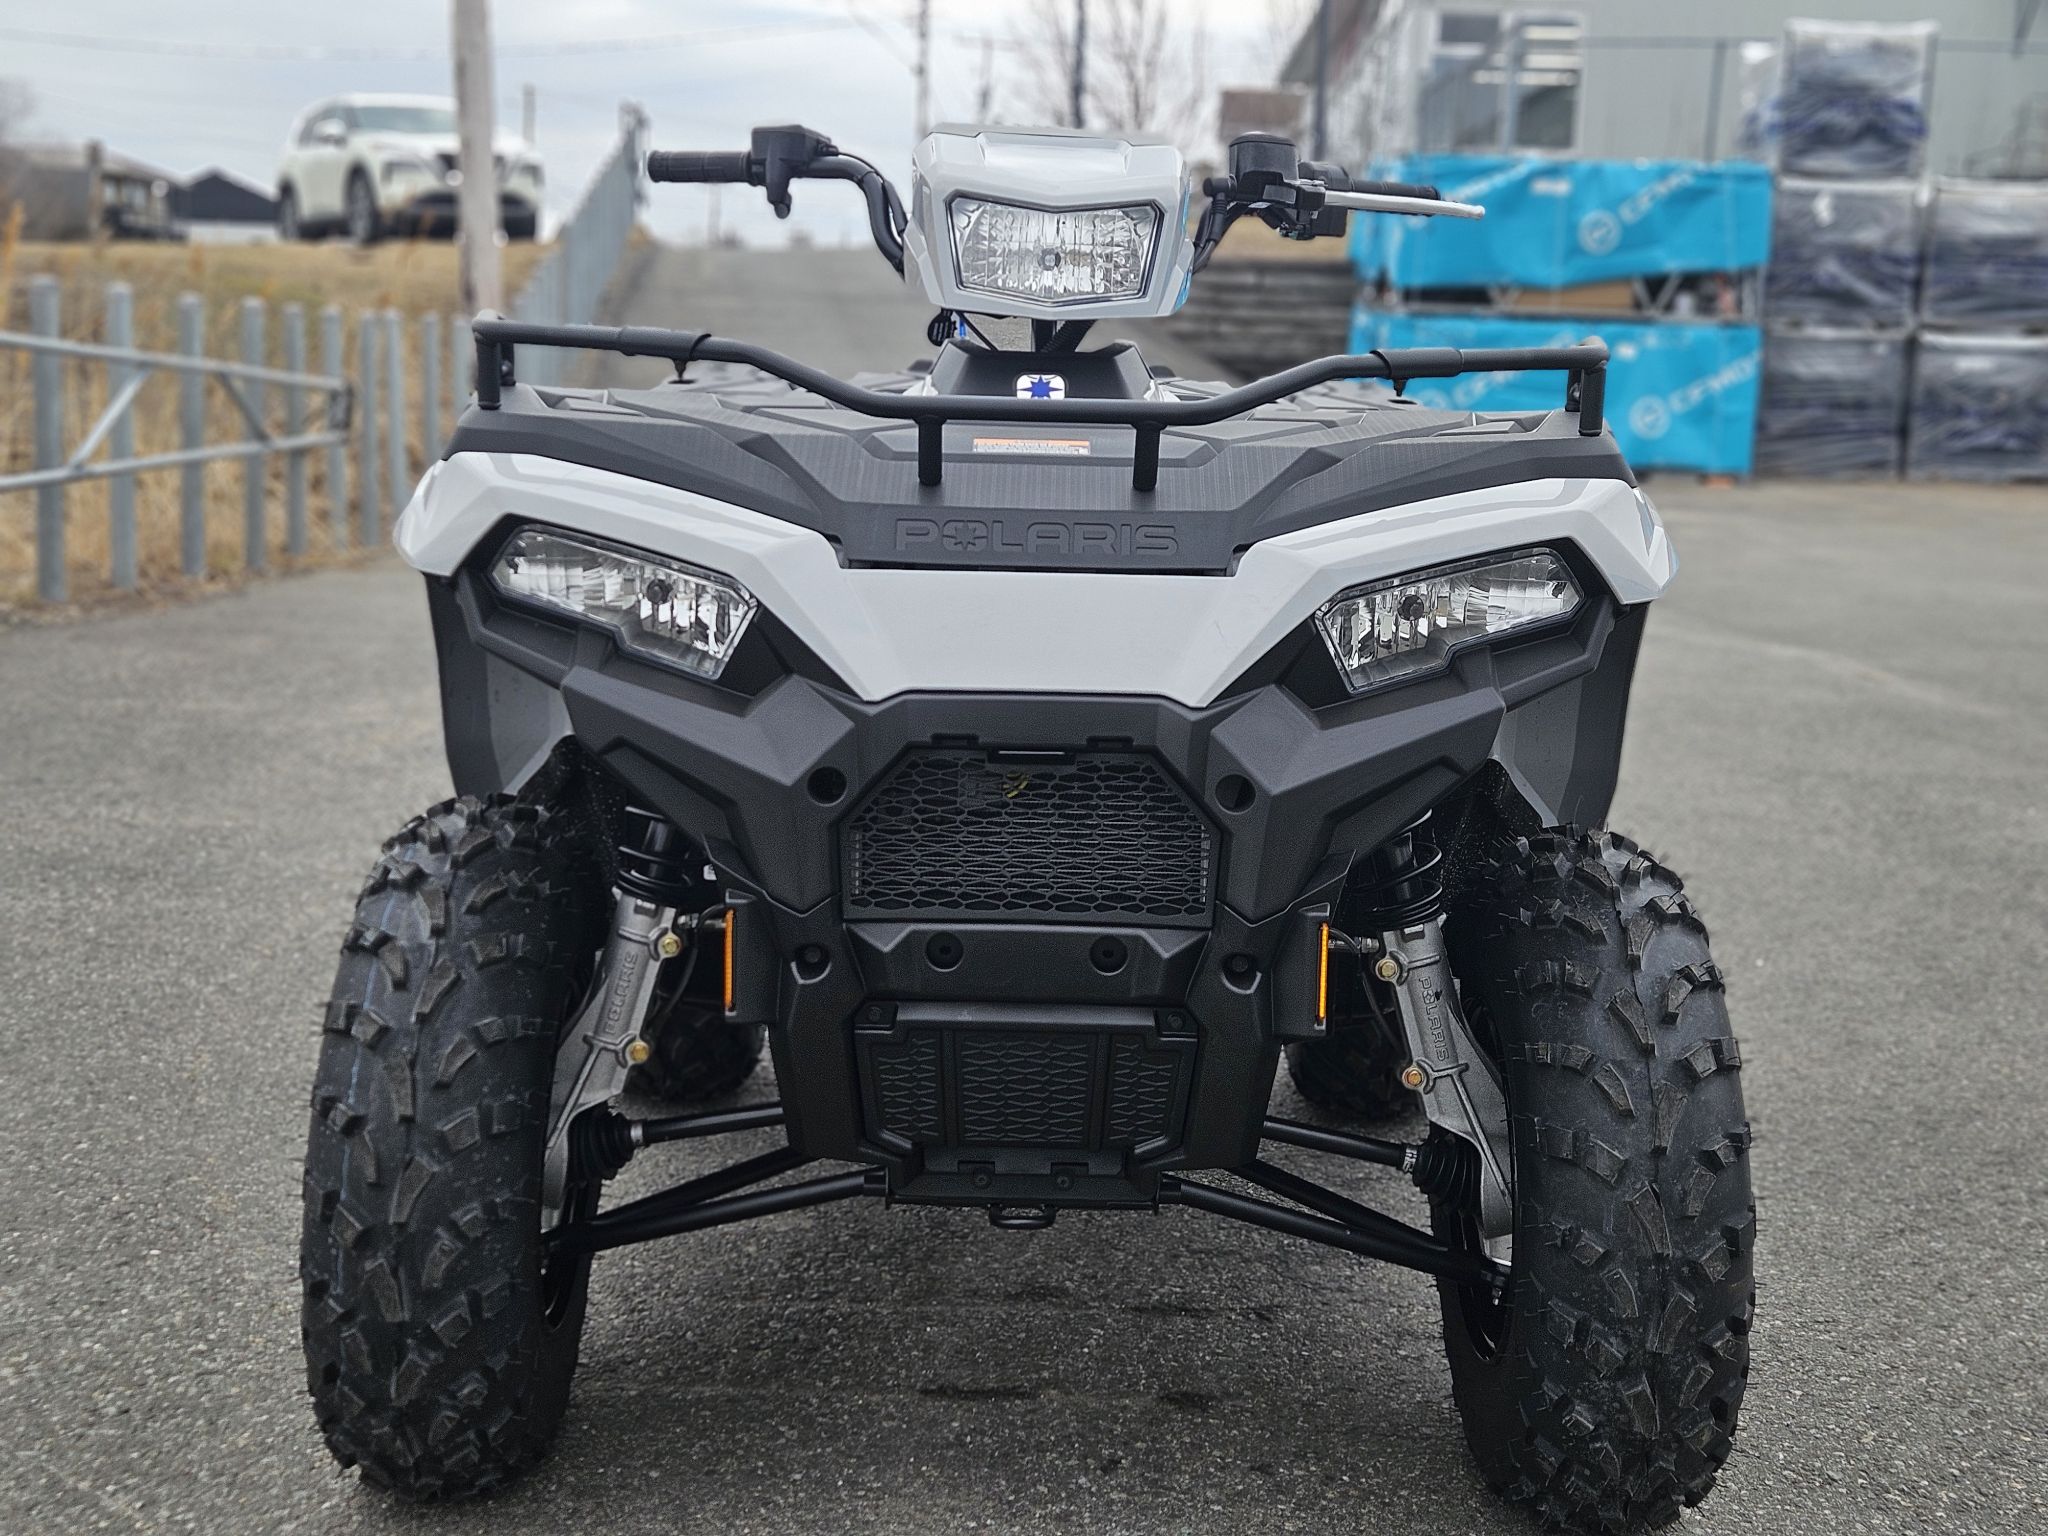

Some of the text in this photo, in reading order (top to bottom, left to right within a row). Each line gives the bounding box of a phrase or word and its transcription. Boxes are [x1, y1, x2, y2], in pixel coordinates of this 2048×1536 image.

[896, 518, 1179, 556] POLARIS
[604, 951, 639, 1035] POLARIS
[1418, 975, 1451, 1062] POLARIS
